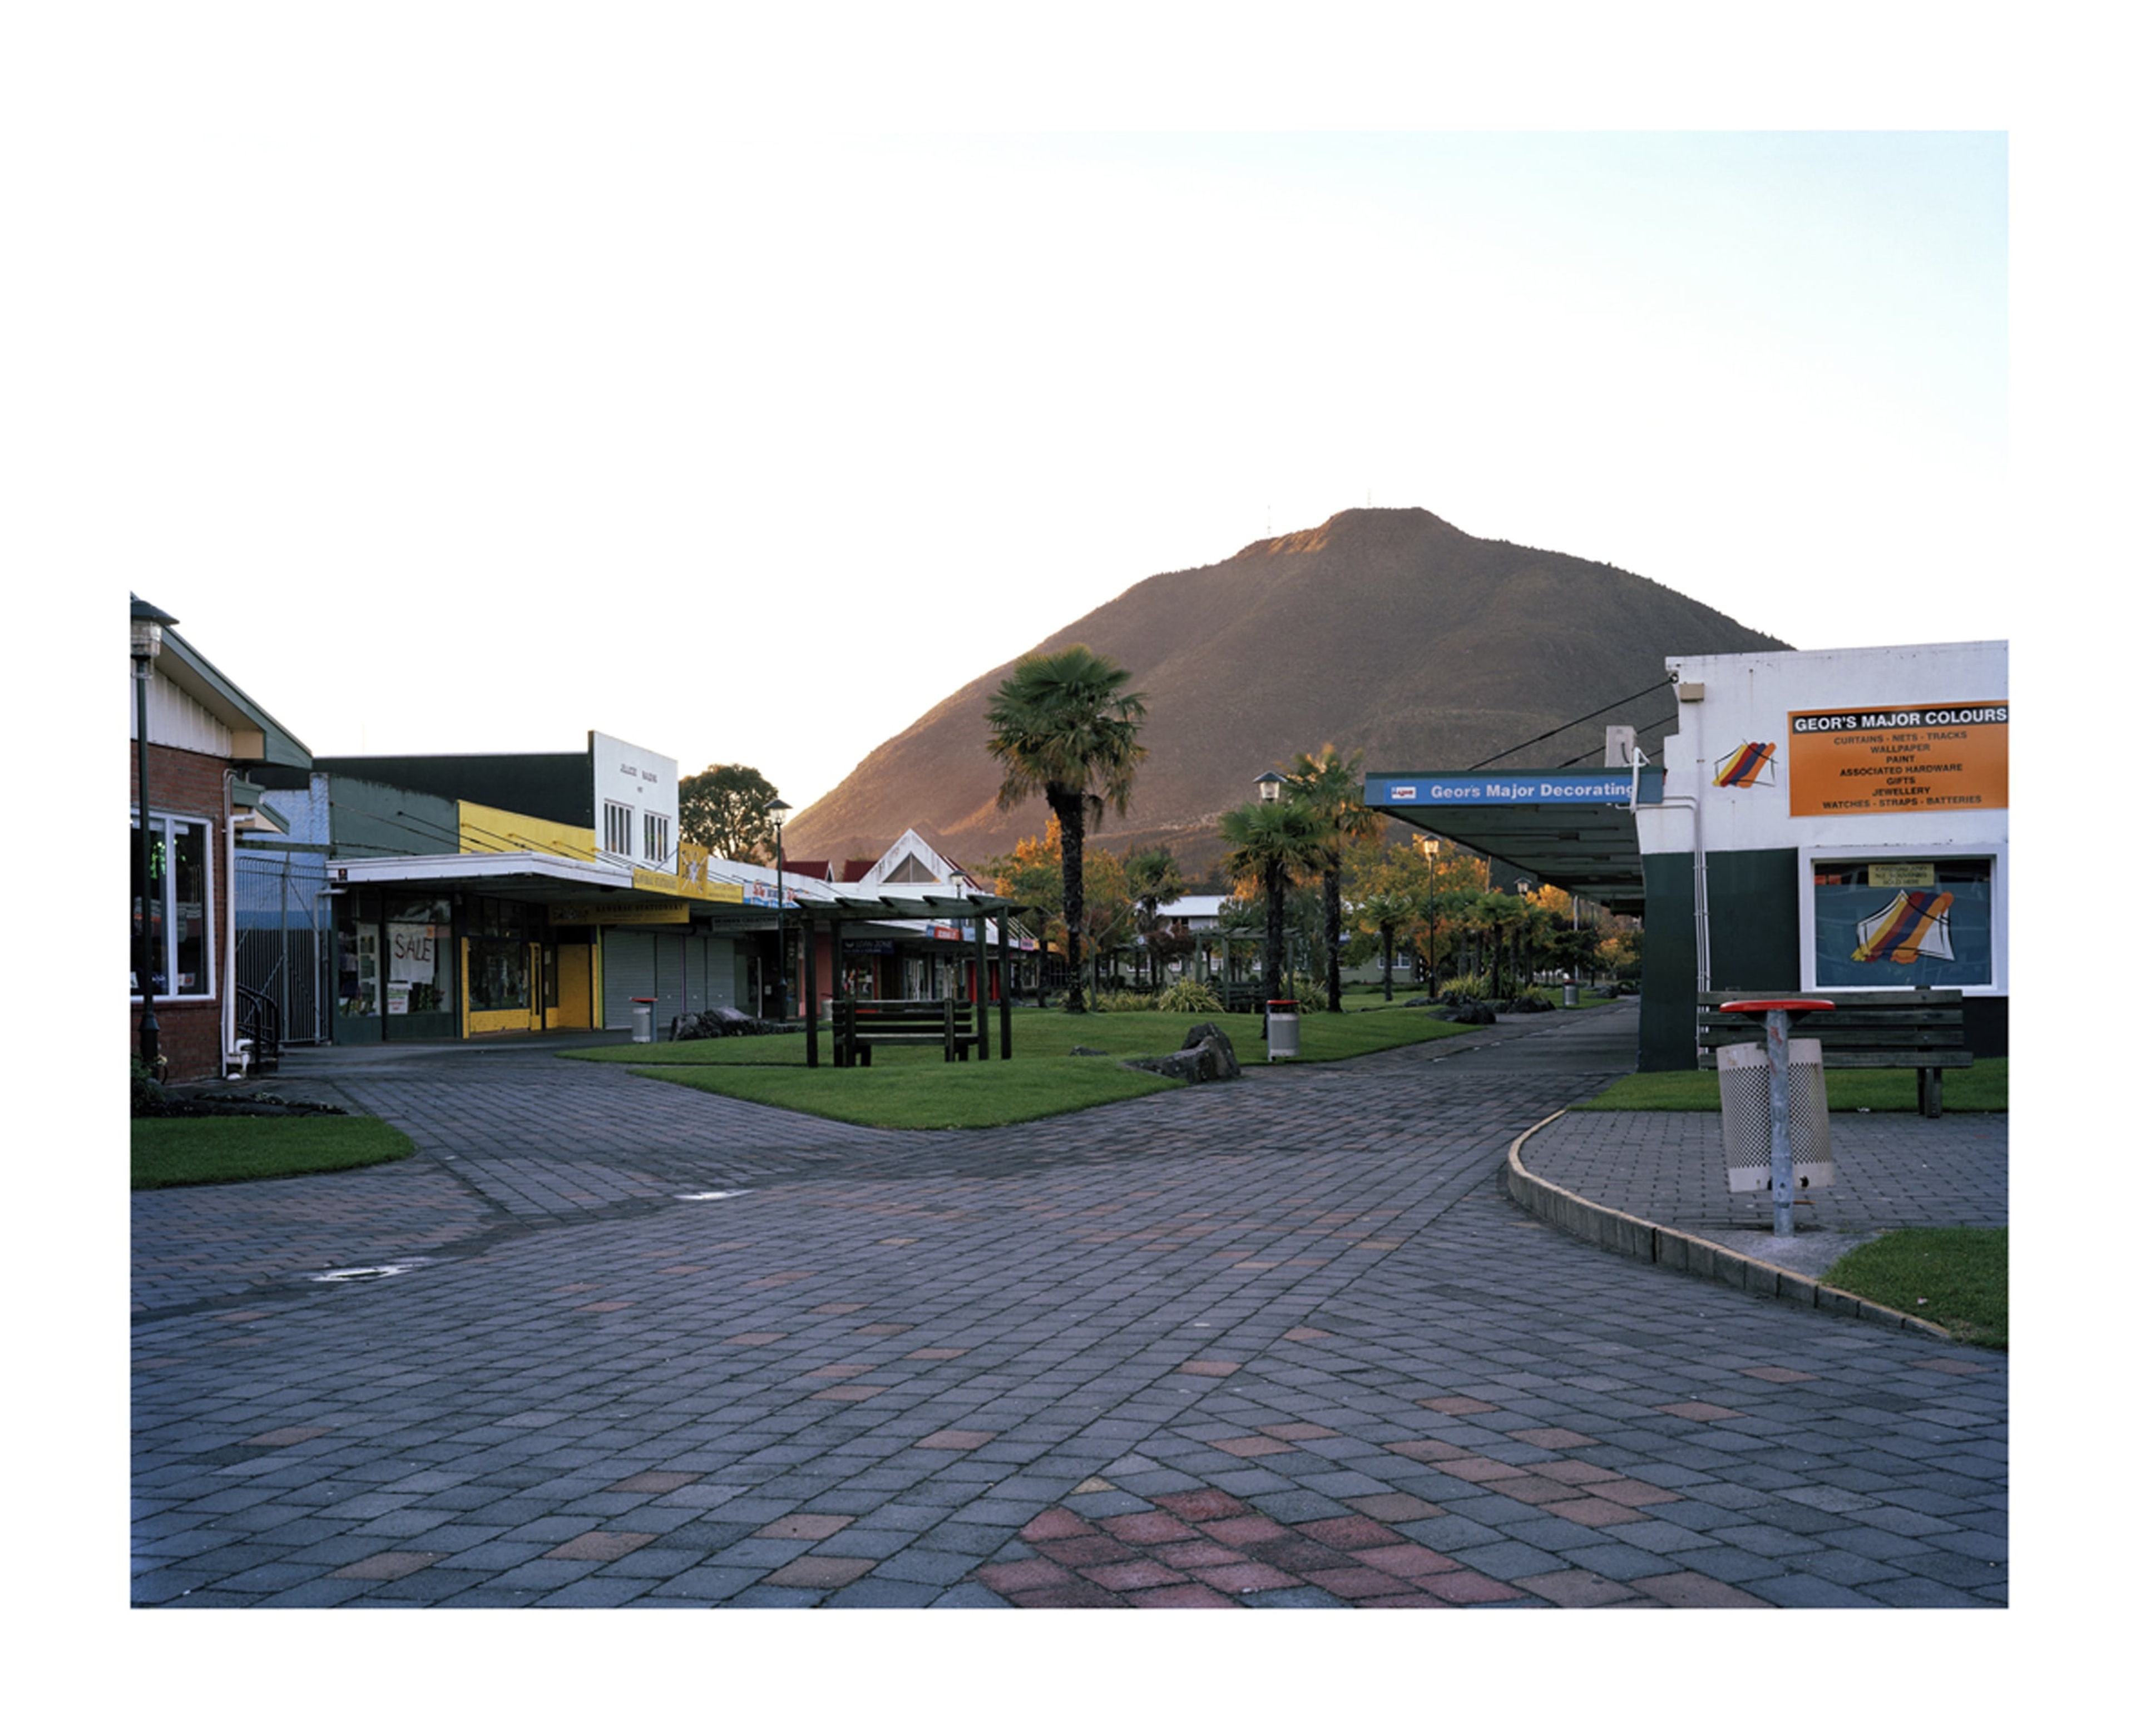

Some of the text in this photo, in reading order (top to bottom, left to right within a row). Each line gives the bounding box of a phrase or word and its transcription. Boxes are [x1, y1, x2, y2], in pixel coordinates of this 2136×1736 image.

[1795, 708, 2008, 731] GEOR'S MAJOR COLOURS
[1833, 735, 1883, 745] CURTAINS
[1927, 731, 1967, 740] TRACKS
[1870, 744, 1931, 754] WALLPAPER
[1886, 755, 1915, 764] PAINT
[1839, 763, 1963, 776] ASSOCIATED HARDWARE
[1886, 776, 1916, 785] GIFTS
[1431, 785, 1481, 798] Geor's
[1486, 783, 1535, 800] Major
[1872, 787, 1931, 797] JEWELLERY
[1822, 800, 1870, 809] WATCHES
[1879, 798, 1918, 807] STRAPS
[1926, 795, 1982, 805] BATTERIES
[394, 932, 433, 962] SALE
